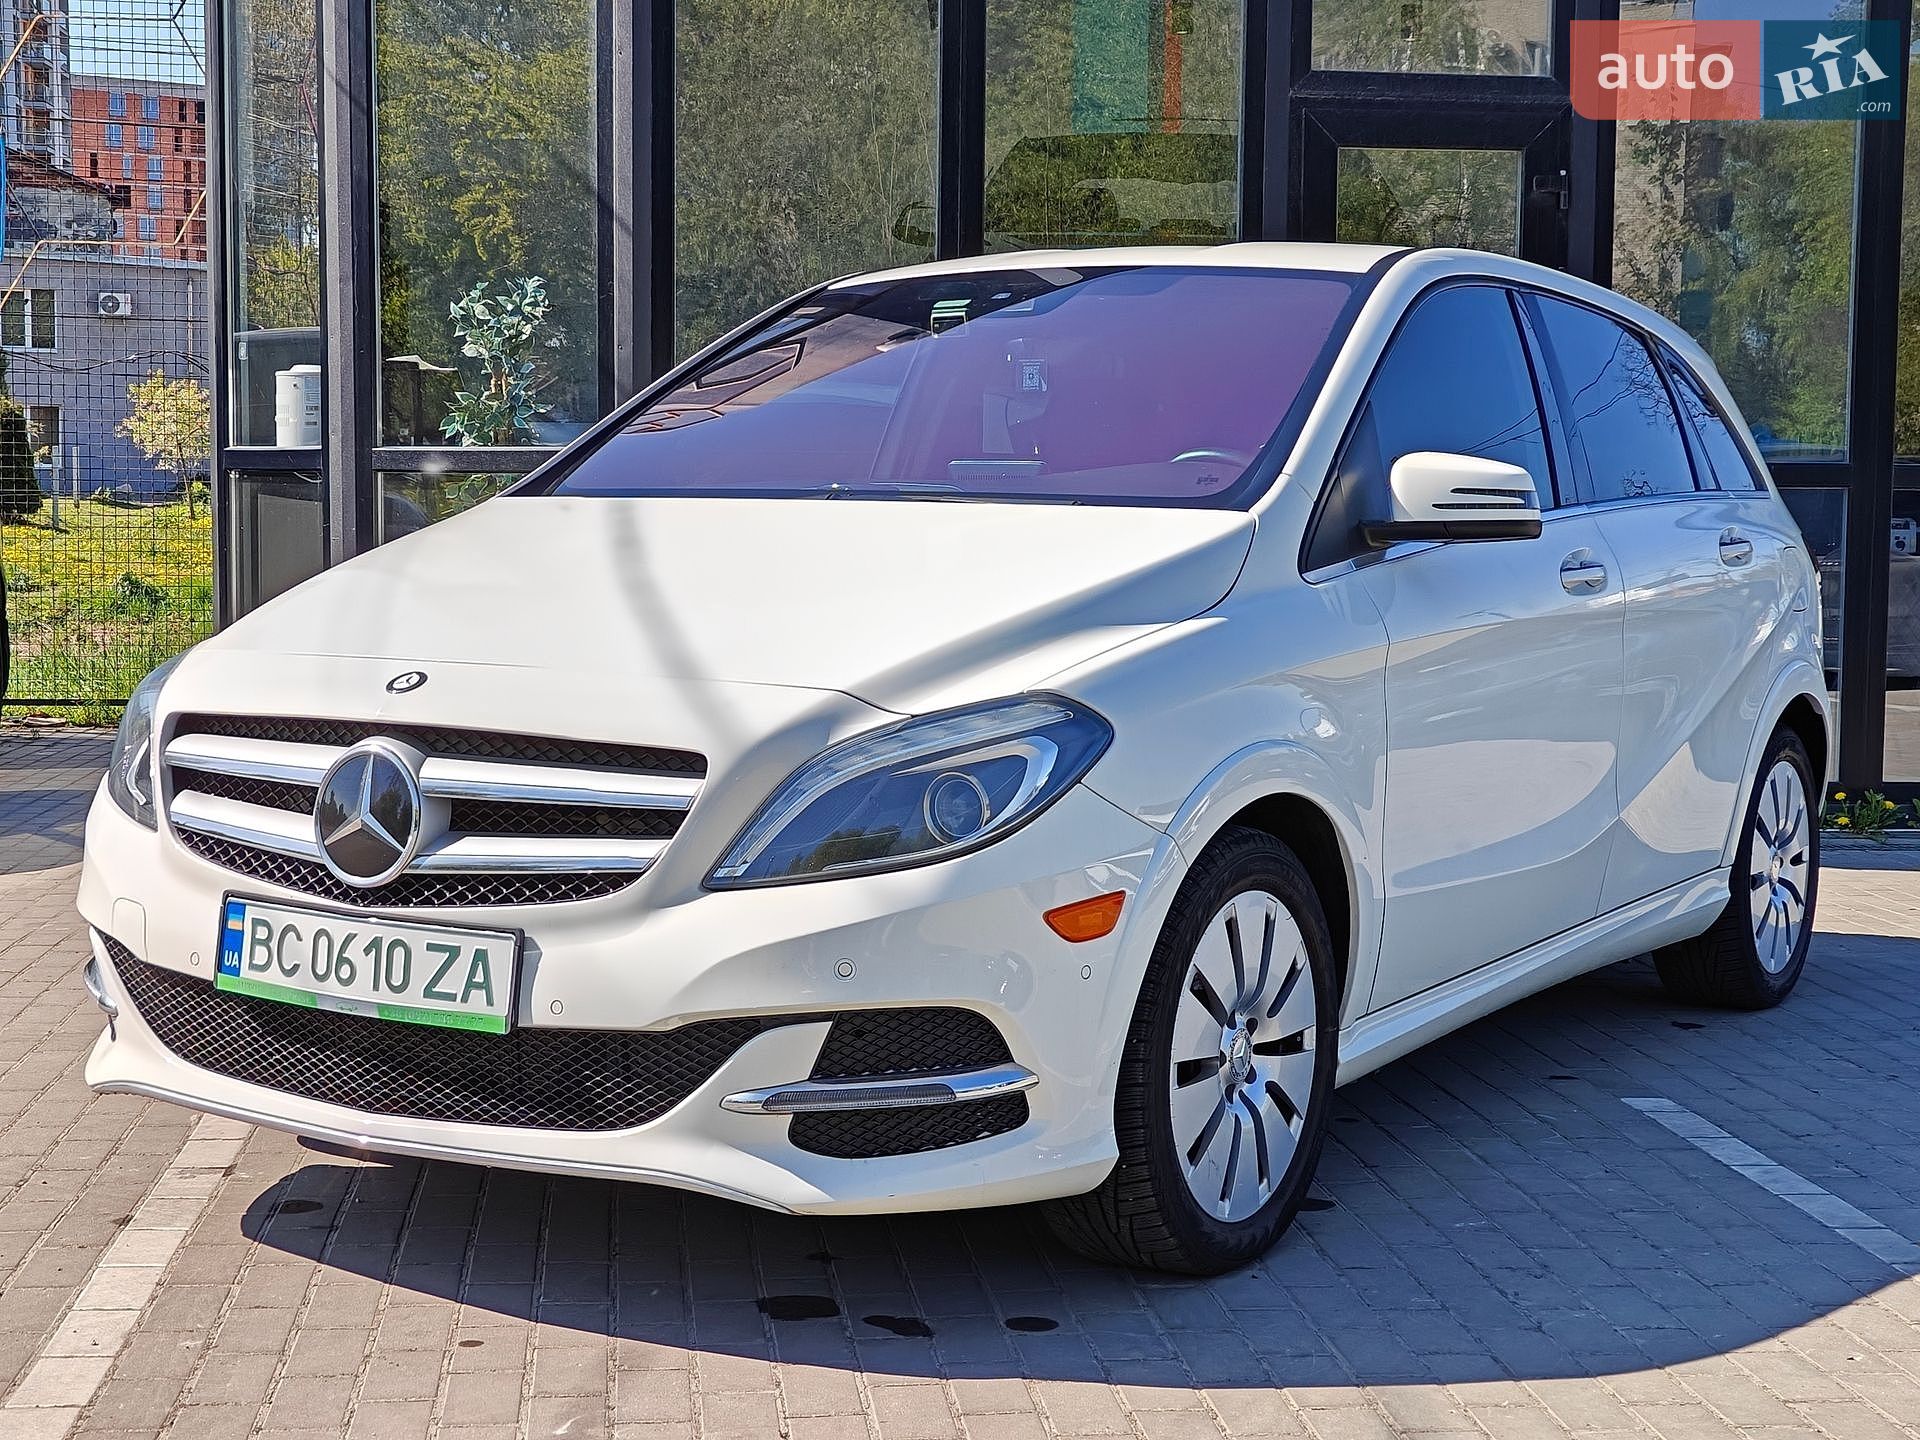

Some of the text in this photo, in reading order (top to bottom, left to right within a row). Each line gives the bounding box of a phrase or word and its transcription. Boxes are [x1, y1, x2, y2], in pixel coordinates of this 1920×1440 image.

[224, 950, 240, 969] UA
[248, 917, 303, 978] BC
[311, 927, 412, 995] 0610
[423, 941, 495, 1007] ZA
